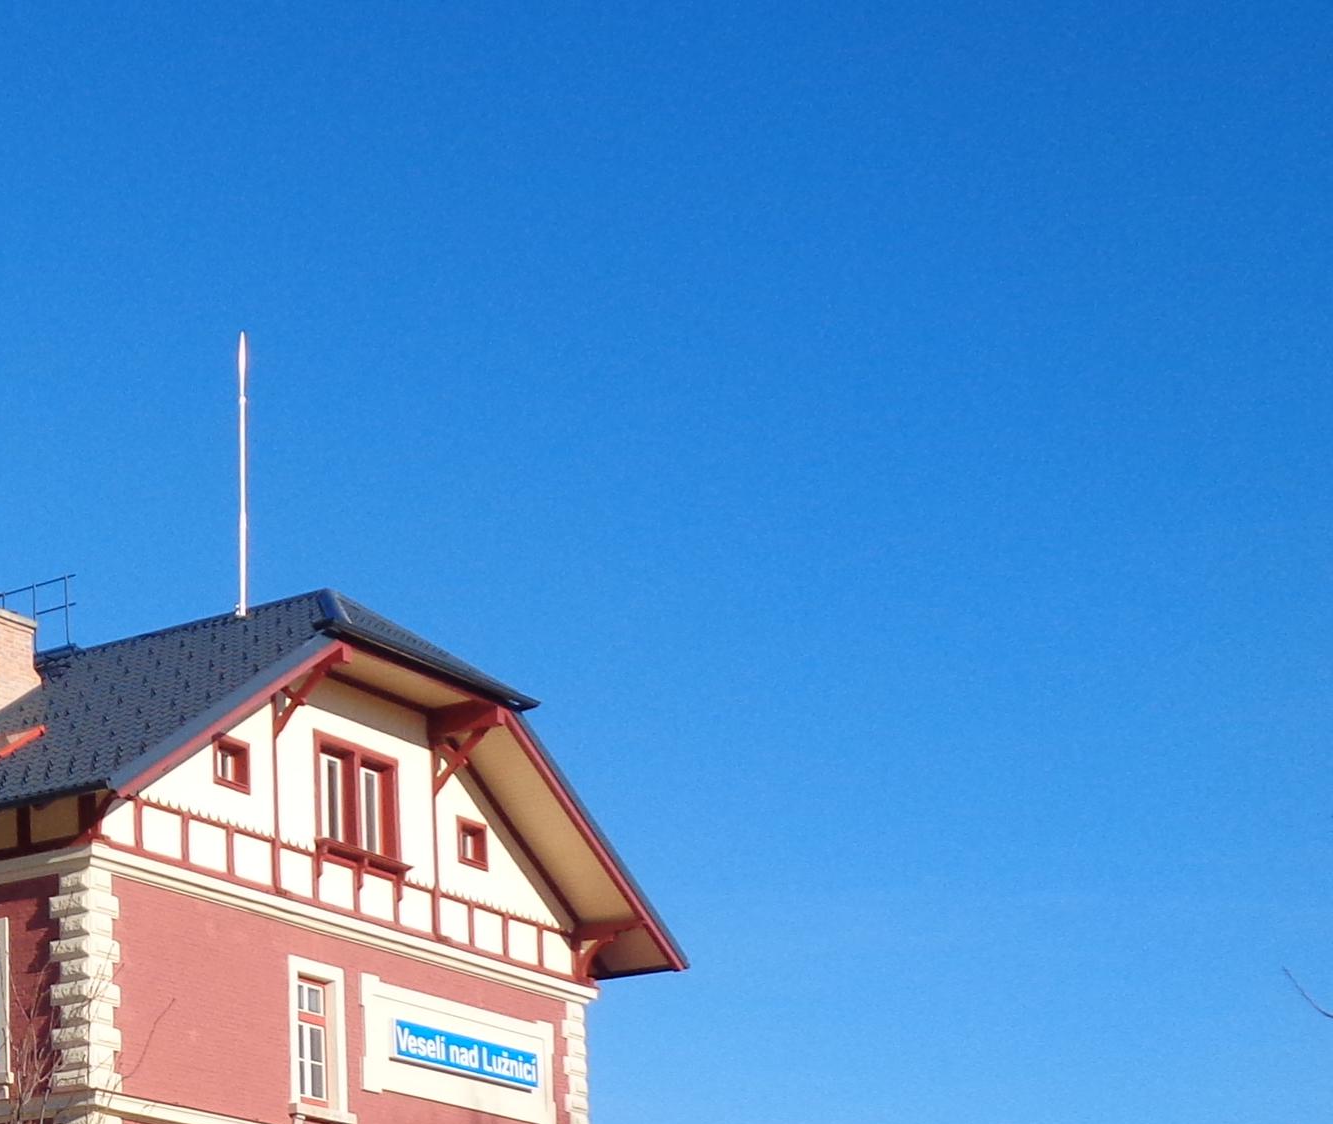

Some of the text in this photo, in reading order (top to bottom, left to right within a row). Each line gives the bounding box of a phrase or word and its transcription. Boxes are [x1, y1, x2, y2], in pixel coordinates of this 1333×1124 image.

[396, 1025, 537, 1082] Veselí nad Lužnicí
